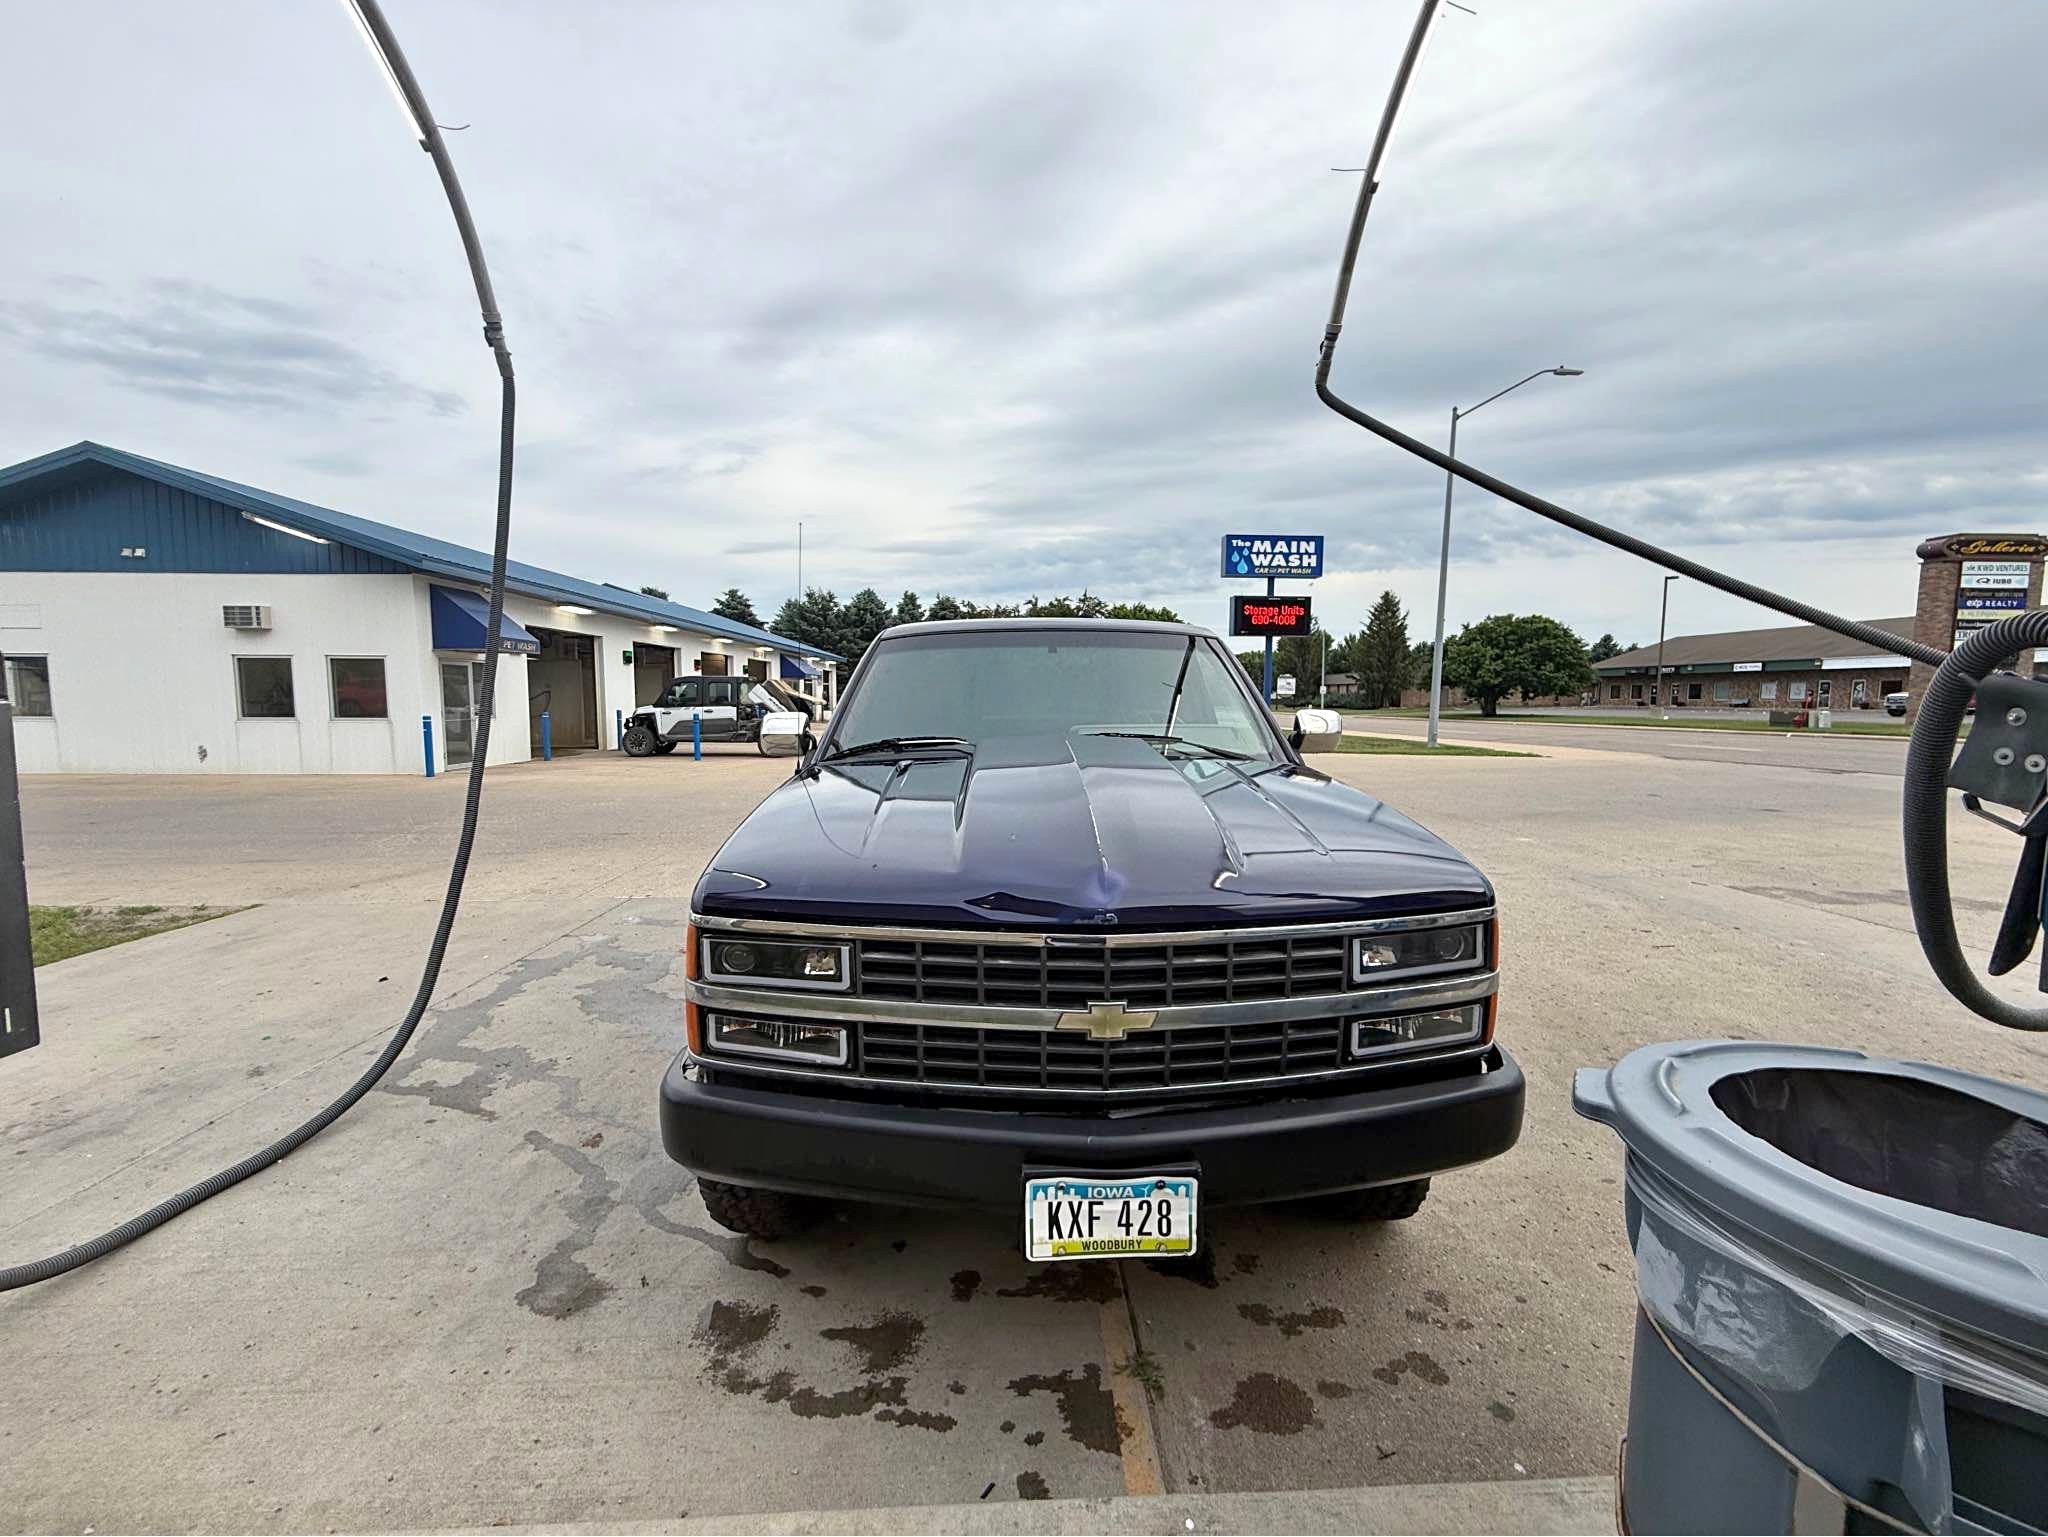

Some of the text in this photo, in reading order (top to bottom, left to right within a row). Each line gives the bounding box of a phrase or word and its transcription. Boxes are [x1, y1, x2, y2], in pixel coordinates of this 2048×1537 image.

[1231, 539, 1251, 547] The
[1252, 540, 1316, 553] MAIN
[1960, 540, 2035, 554] Galleria
[1250, 554, 1317, 567] WASH
[1244, 605, 1305, 616] Storage Units
[1251, 615, 1296, 625] 690-4008
[503, 640, 537, 651] PET WASH
[1087, 1186, 1135, 1199] IOWA
[1048, 1199, 1172, 1240] KXF 428
[1081, 1239, 1143, 1251] WOODBURY
